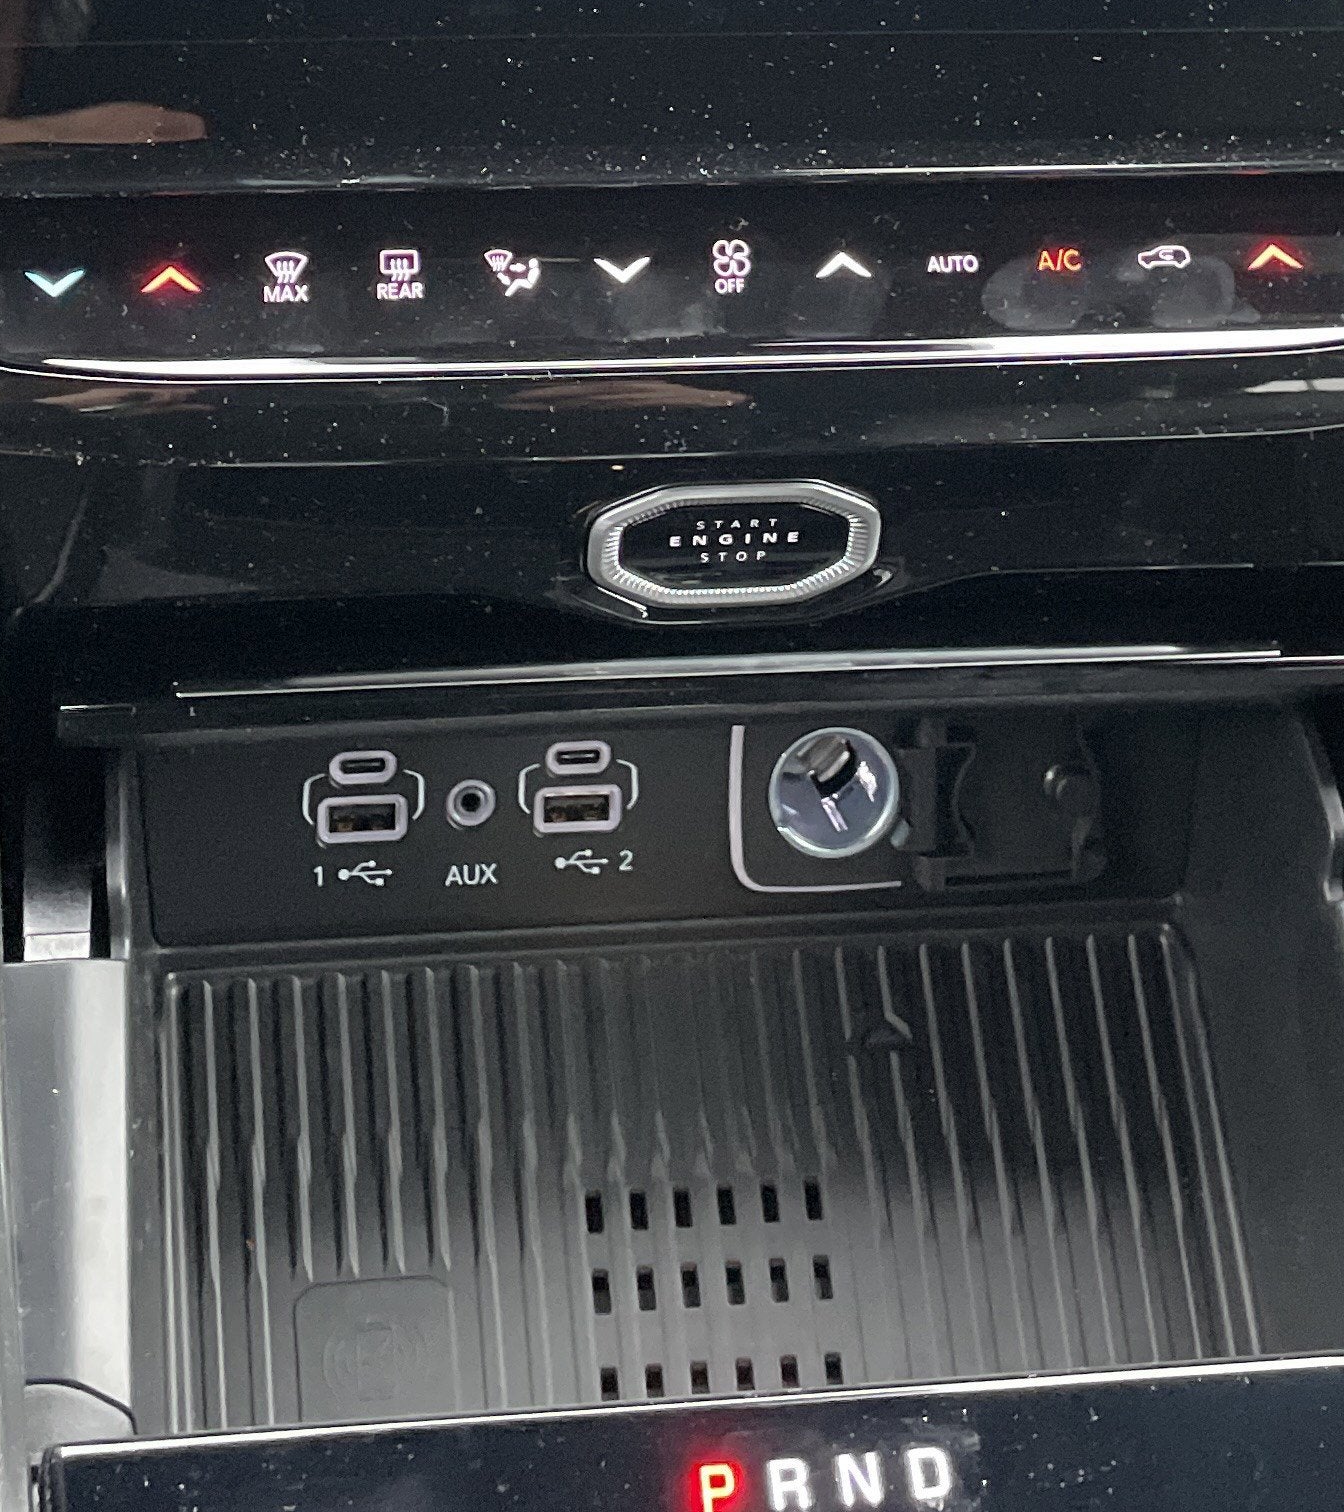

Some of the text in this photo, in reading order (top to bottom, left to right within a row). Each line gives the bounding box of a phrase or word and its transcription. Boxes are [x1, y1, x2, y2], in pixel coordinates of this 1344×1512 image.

[927, 254, 979, 274] AUTO
[1036, 248, 1083, 273] A/C
[263, 285, 309, 303] MAX
[376, 282, 424, 300] REAR
[714, 278, 745, 295] OFF
[696, 518, 778, 531] START
[669, 531, 799, 548] ENGINE
[700, 550, 766, 563] STOP
[618, 849, 634, 872] 2
[313, 865, 324, 887] 1
[444, 863, 498, 887] AUX
[698, 1445, 953, 1512] P R N D
